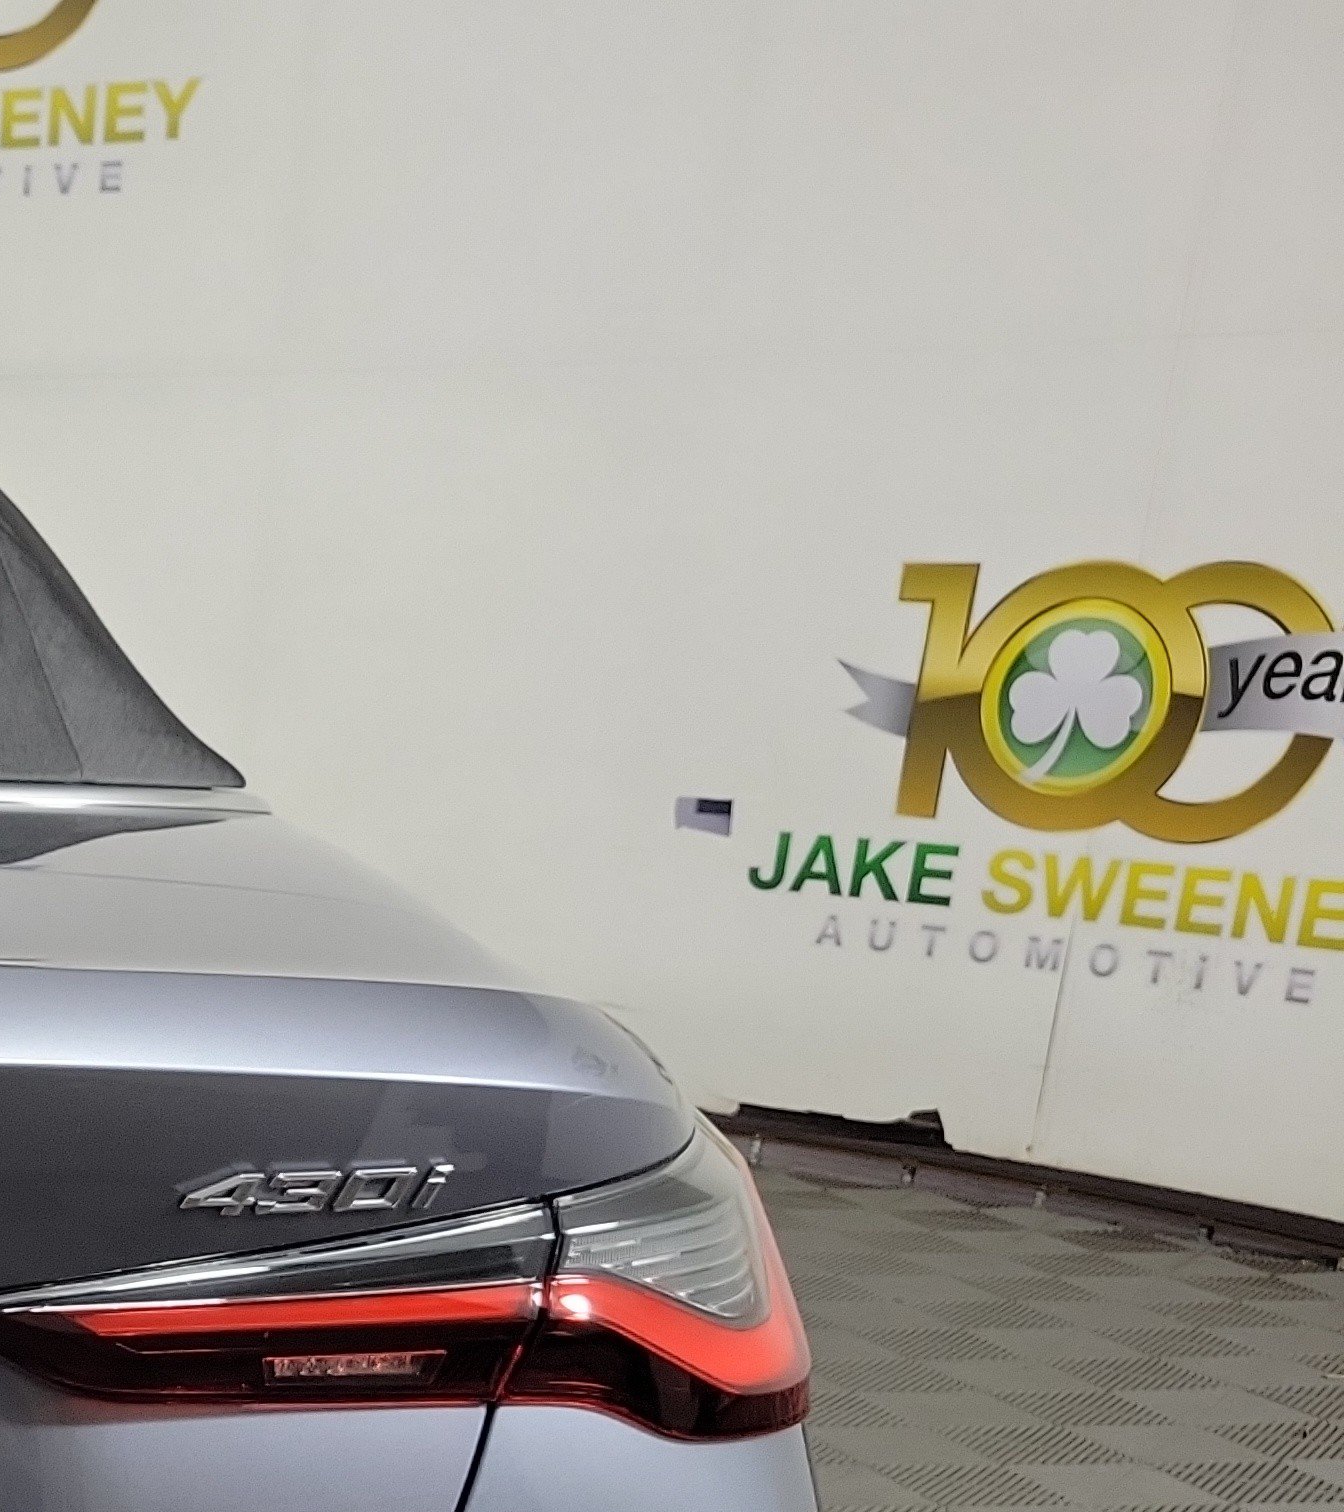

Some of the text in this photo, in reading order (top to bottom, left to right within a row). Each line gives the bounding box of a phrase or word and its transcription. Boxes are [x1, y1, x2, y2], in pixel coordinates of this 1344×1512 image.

[1217, 650, 1344, 718] yea
[747, 831, 960, 907] JAKE
[815, 914, 1316, 1005] AUTOMOTIVE
[179, 1163, 455, 1217] 430i
